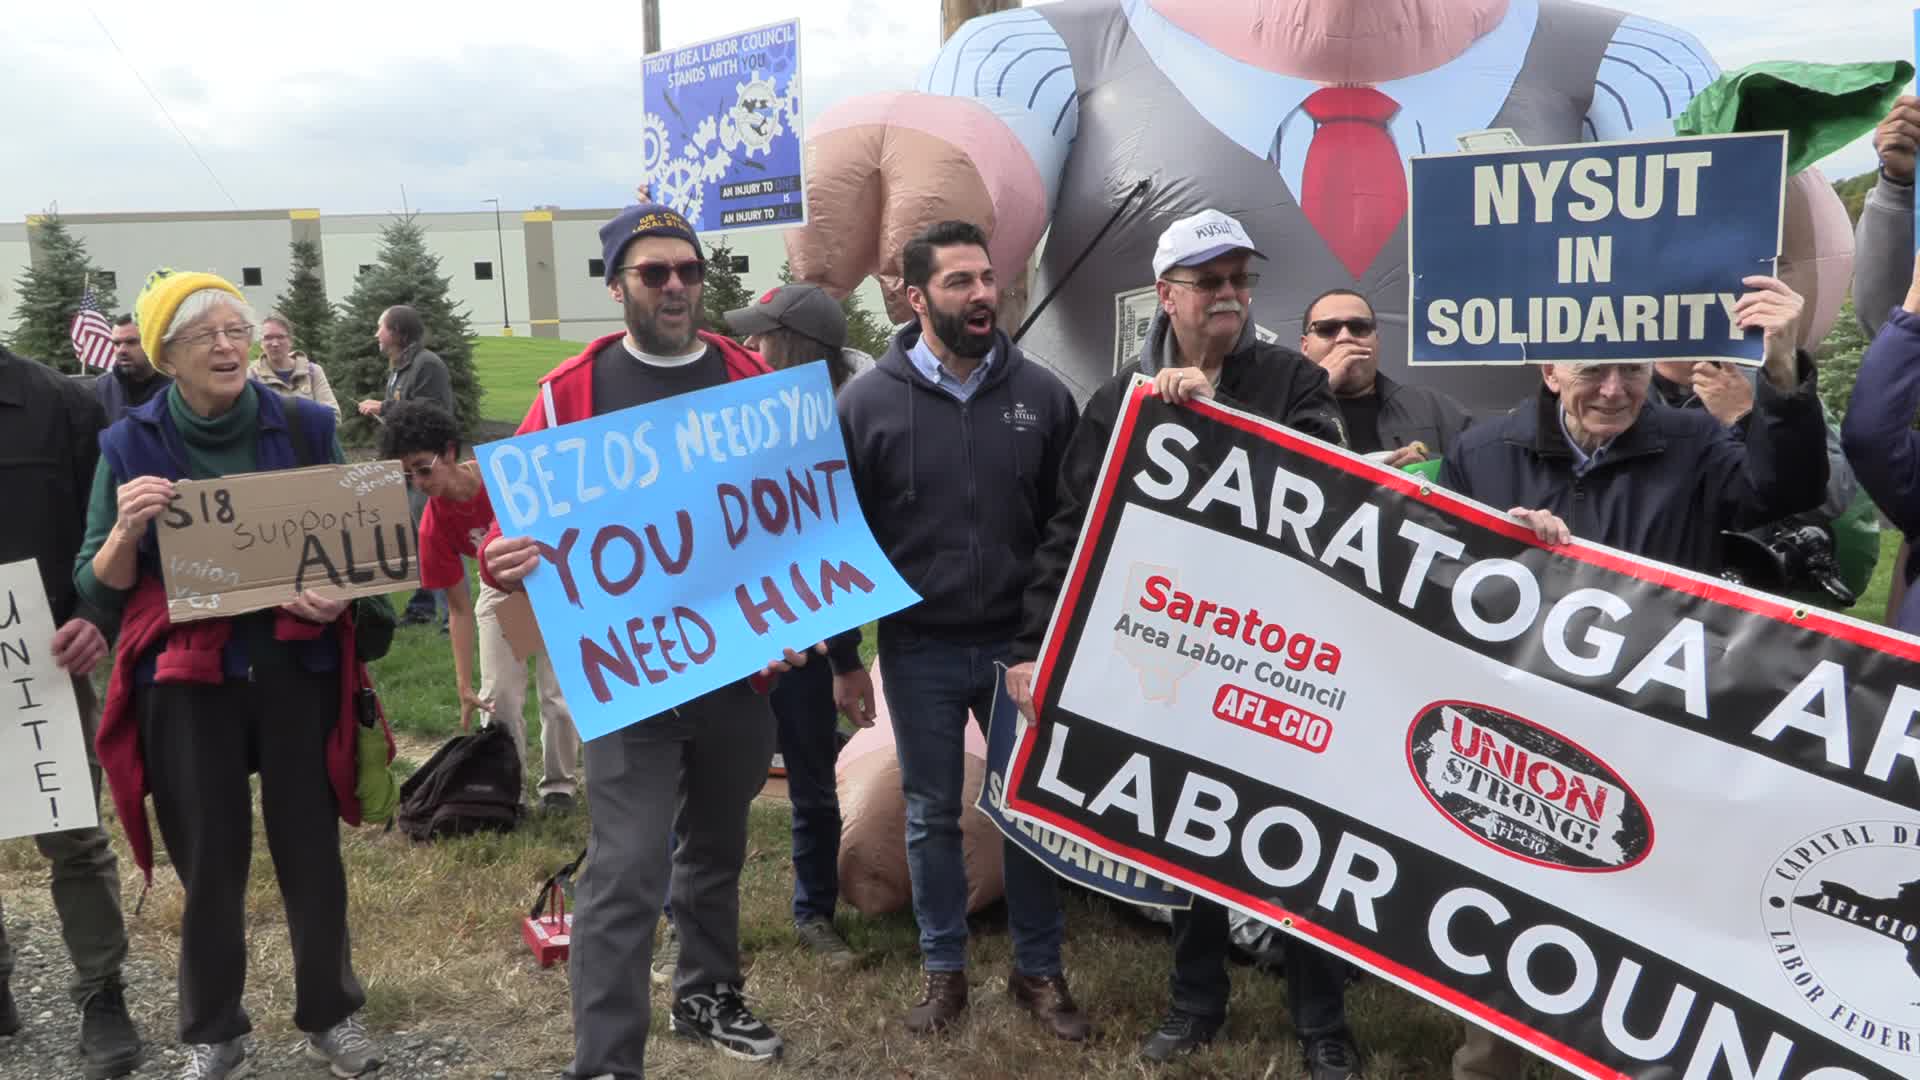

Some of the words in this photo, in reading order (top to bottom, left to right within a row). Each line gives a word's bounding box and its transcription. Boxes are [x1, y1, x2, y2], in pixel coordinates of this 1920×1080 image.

[645, 55, 672, 76] TROY
[673, 48, 701, 69] AREA
[702, 39, 738, 61] LABOR
[741, 25, 794, 52] COUNCIL
[668, 65, 706, 89] STANDS
[708, 58, 738, 79] WITH
[741, 53, 766, 71] YOU
[722, 186, 733, 198] AN
[735, 182, 760, 196] INJURY
[762, 181, 773, 192] TO
[724, 213, 734, 224] AN
[736, 209, 761, 222] INJURY
[764, 208, 775, 219] TO
[783, 192, 790, 204] IS
[1474, 151, 1713, 226] NYSUT
[1558, 236, 1612, 284] IN
[1427, 293, 1745, 345] SOLIDARITY
[489, 421, 659, 528] BEZOS
[675, 397, 781, 473] NEEDS
[778, 385, 833, 448] YOU
[296, 524, 408, 592] ALU
[534, 510, 693, 610] YOU
[717, 459, 846, 550] DONT
[1133, 423, 1709, 720] SARATOGA
[579, 607, 716, 704] NEED
[735, 558, 876, 635] HIM
[1140, 575, 1342, 675] Saratoga
[1114, 614, 1169, 648] Area
[1177, 634, 1248, 674] Labor
[1255, 661, 1347, 710] Council
[1217, 688, 1328, 748] AFL-CIO
[1441, 758, 1599, 850] STRONG!
[1451, 716, 1608, 822] UNION
[1775, 825, 1875, 881] CAPITAL
[1037, 723, 1398, 933] LABOR
[1428, 887, 1873, 1080] COUN
[1816, 895, 1917, 942] AFL-CIO
[1770, 930, 1825, 1003] LABOR
[1830, 1004, 1920, 1054] FEDER
